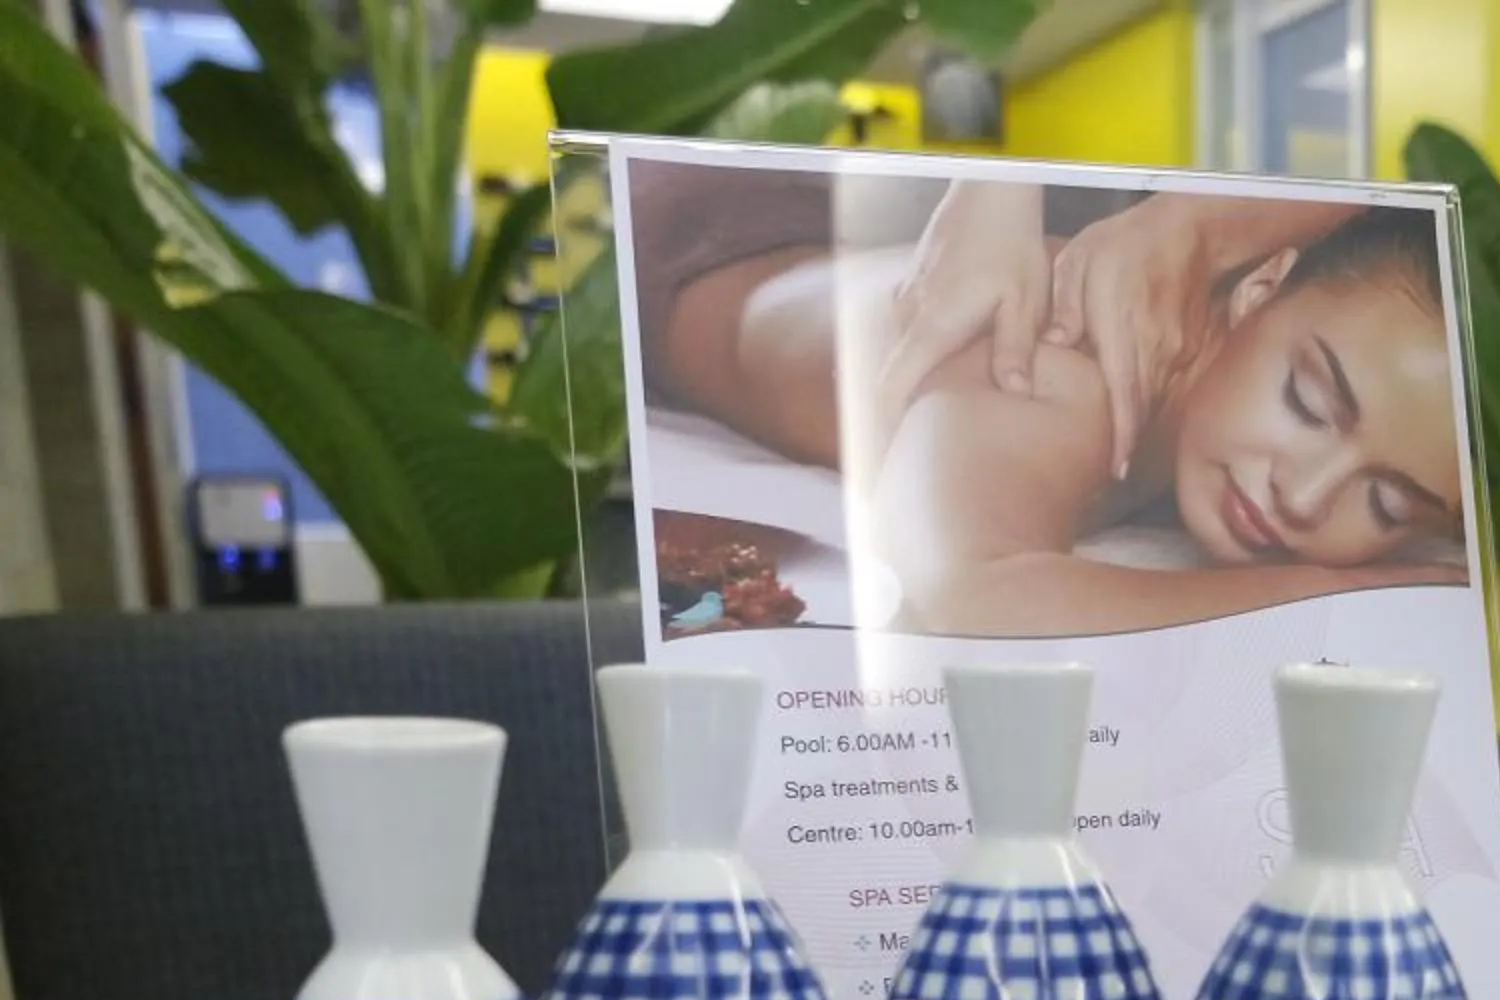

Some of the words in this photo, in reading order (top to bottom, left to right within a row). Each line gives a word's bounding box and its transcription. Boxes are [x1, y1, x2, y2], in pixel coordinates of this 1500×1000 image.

[777, 688, 882, 710] OPENING
[781, 735, 832, 753] Pool:
[837, 731, 915, 752] 6.00AM
[921, 731, 951, 749] -11
[1089, 725, 1120, 747] aily
[784, 780, 825, 801] Spa
[832, 776, 938, 797] treatments
[945, 775, 960, 792] &
[788, 823, 863, 843] Centre:
[869, 818, 974, 840] 10.00am-1
[1118, 809, 1161, 830] daily
[849, 888, 892, 908] SPA
[880, 932, 910, 950] Ma
